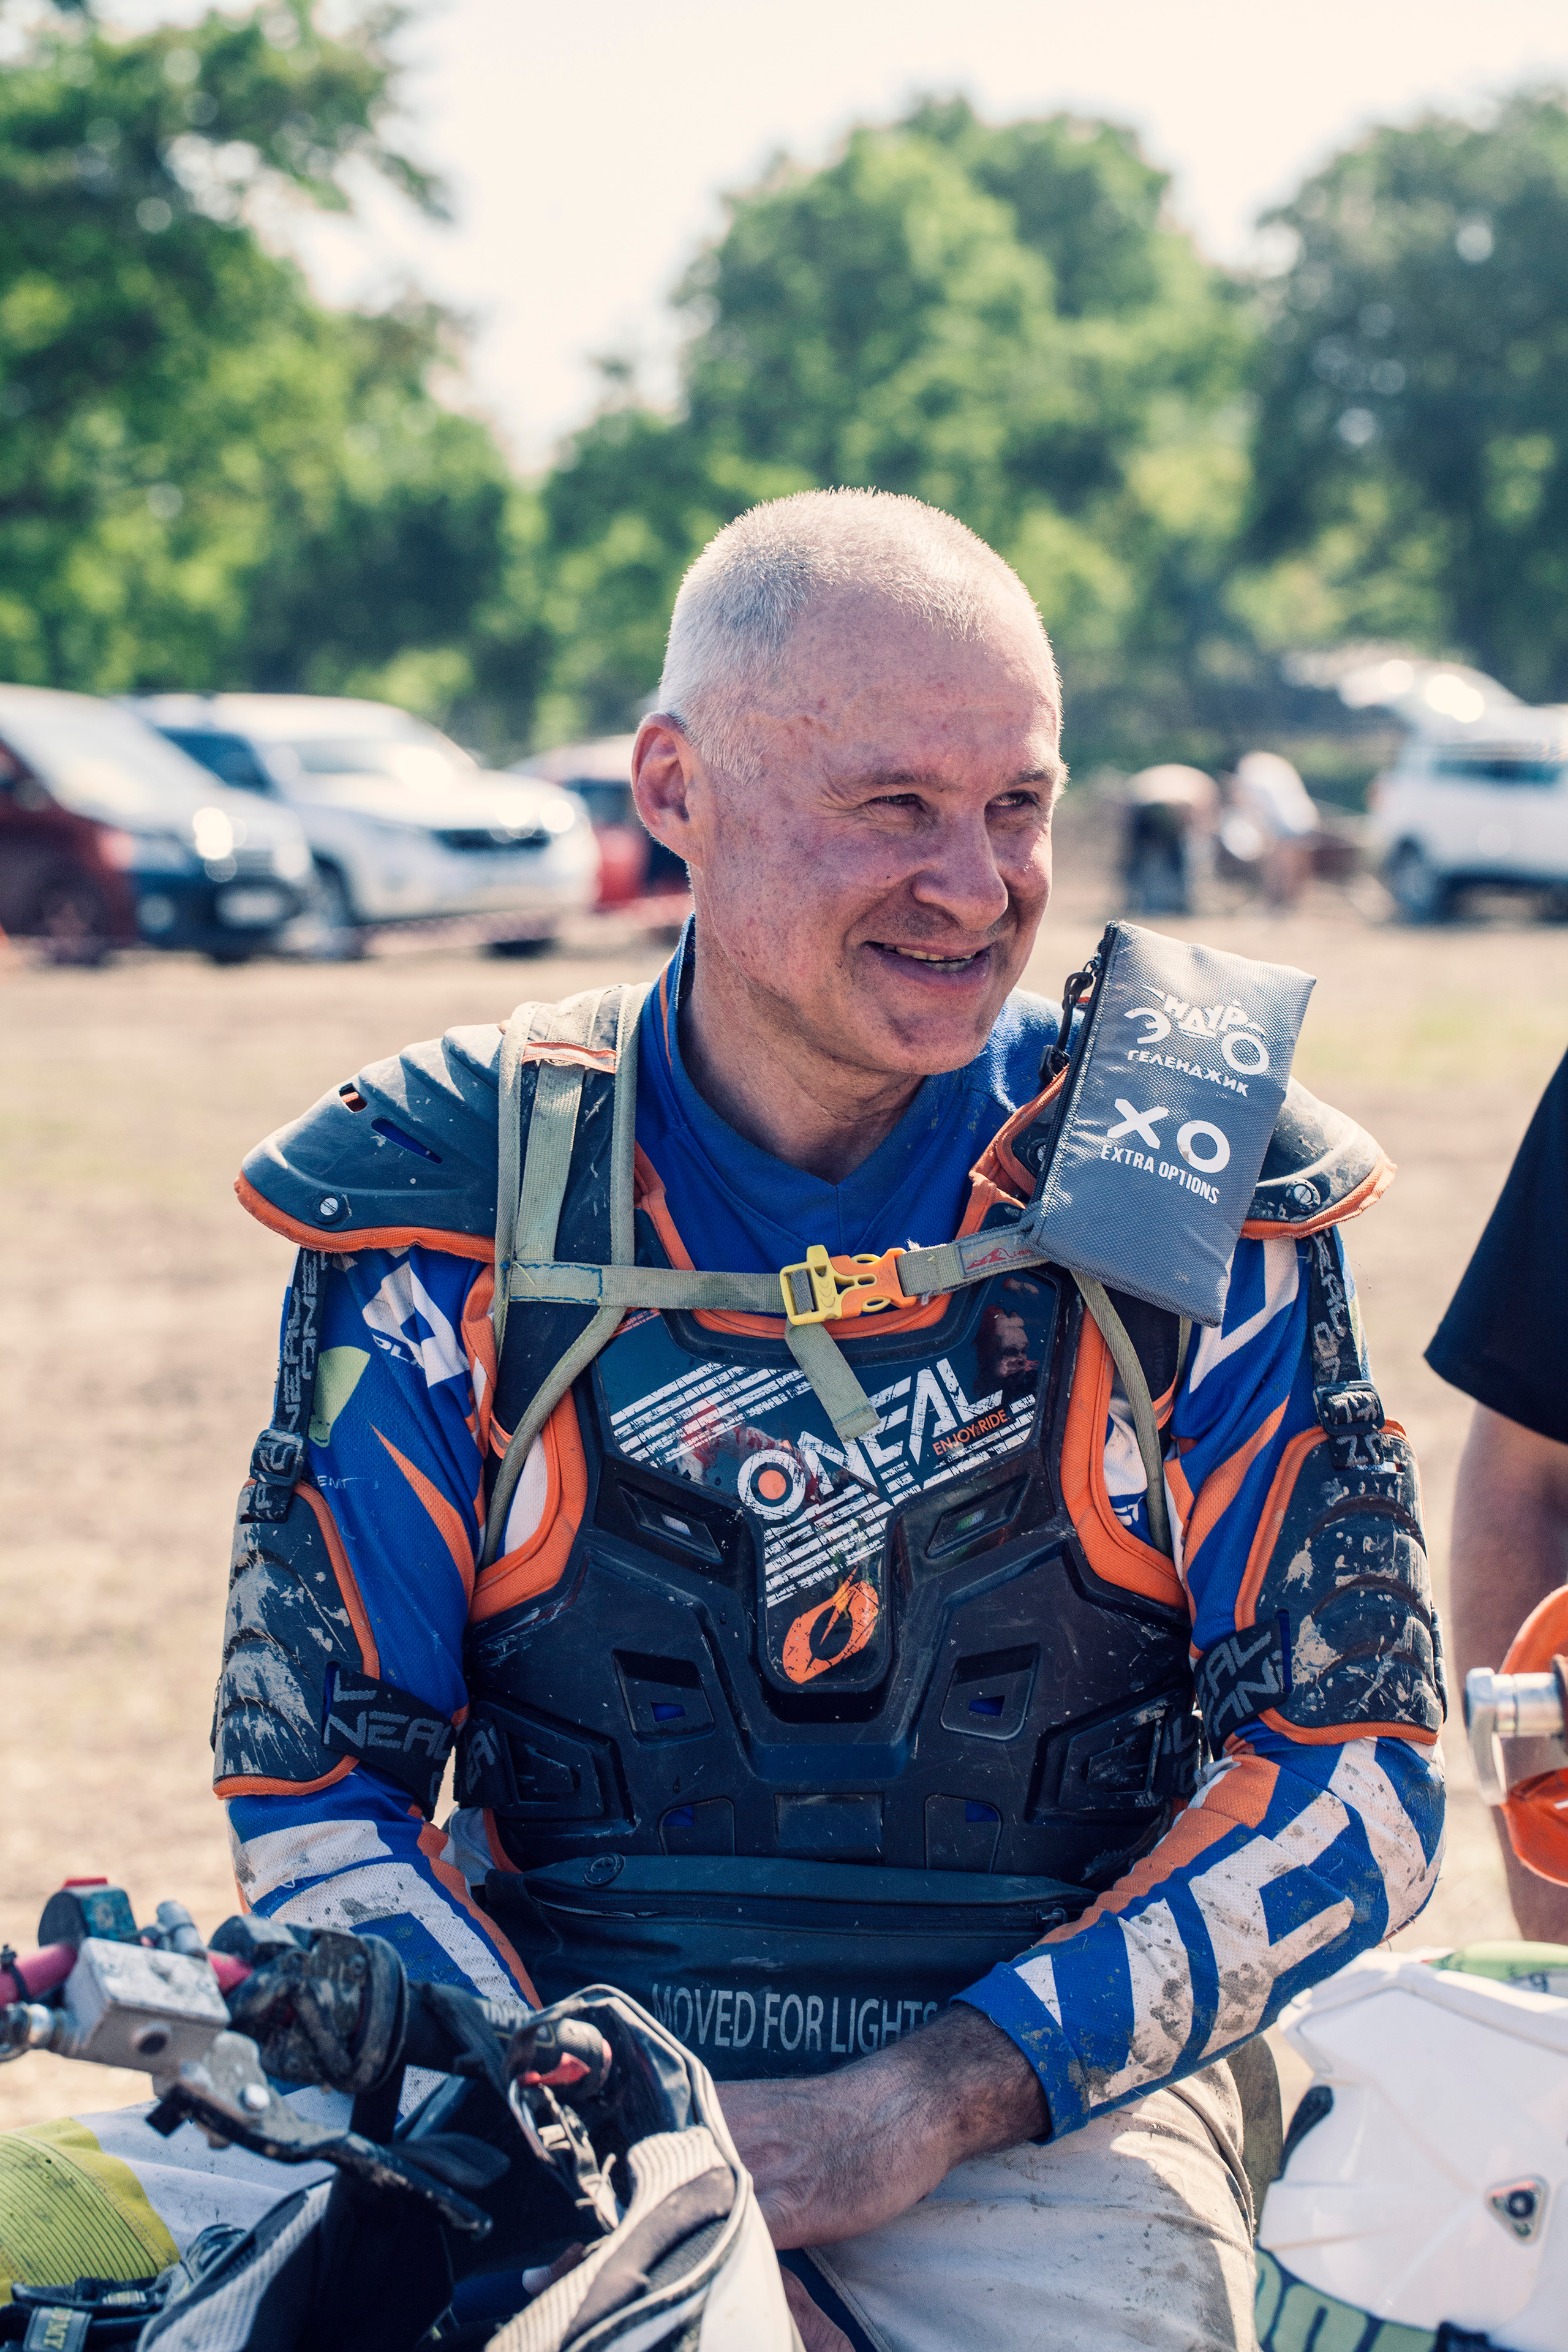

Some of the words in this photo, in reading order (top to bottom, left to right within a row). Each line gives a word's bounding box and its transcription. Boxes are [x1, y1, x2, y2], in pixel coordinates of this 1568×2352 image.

[1128, 1049, 1249, 1098] ГЕЛЕНДЖИК
[1100, 1144, 1155, 1174] EXTRA
[1158, 1161, 1219, 1205] OPTIONS
[932, 1423, 976, 1456] ENJOY
[978, 1409, 1011, 1433] RIDE.
[652, 1983, 756, 2048] MOVED
[762, 1992, 824, 2051] FOR
